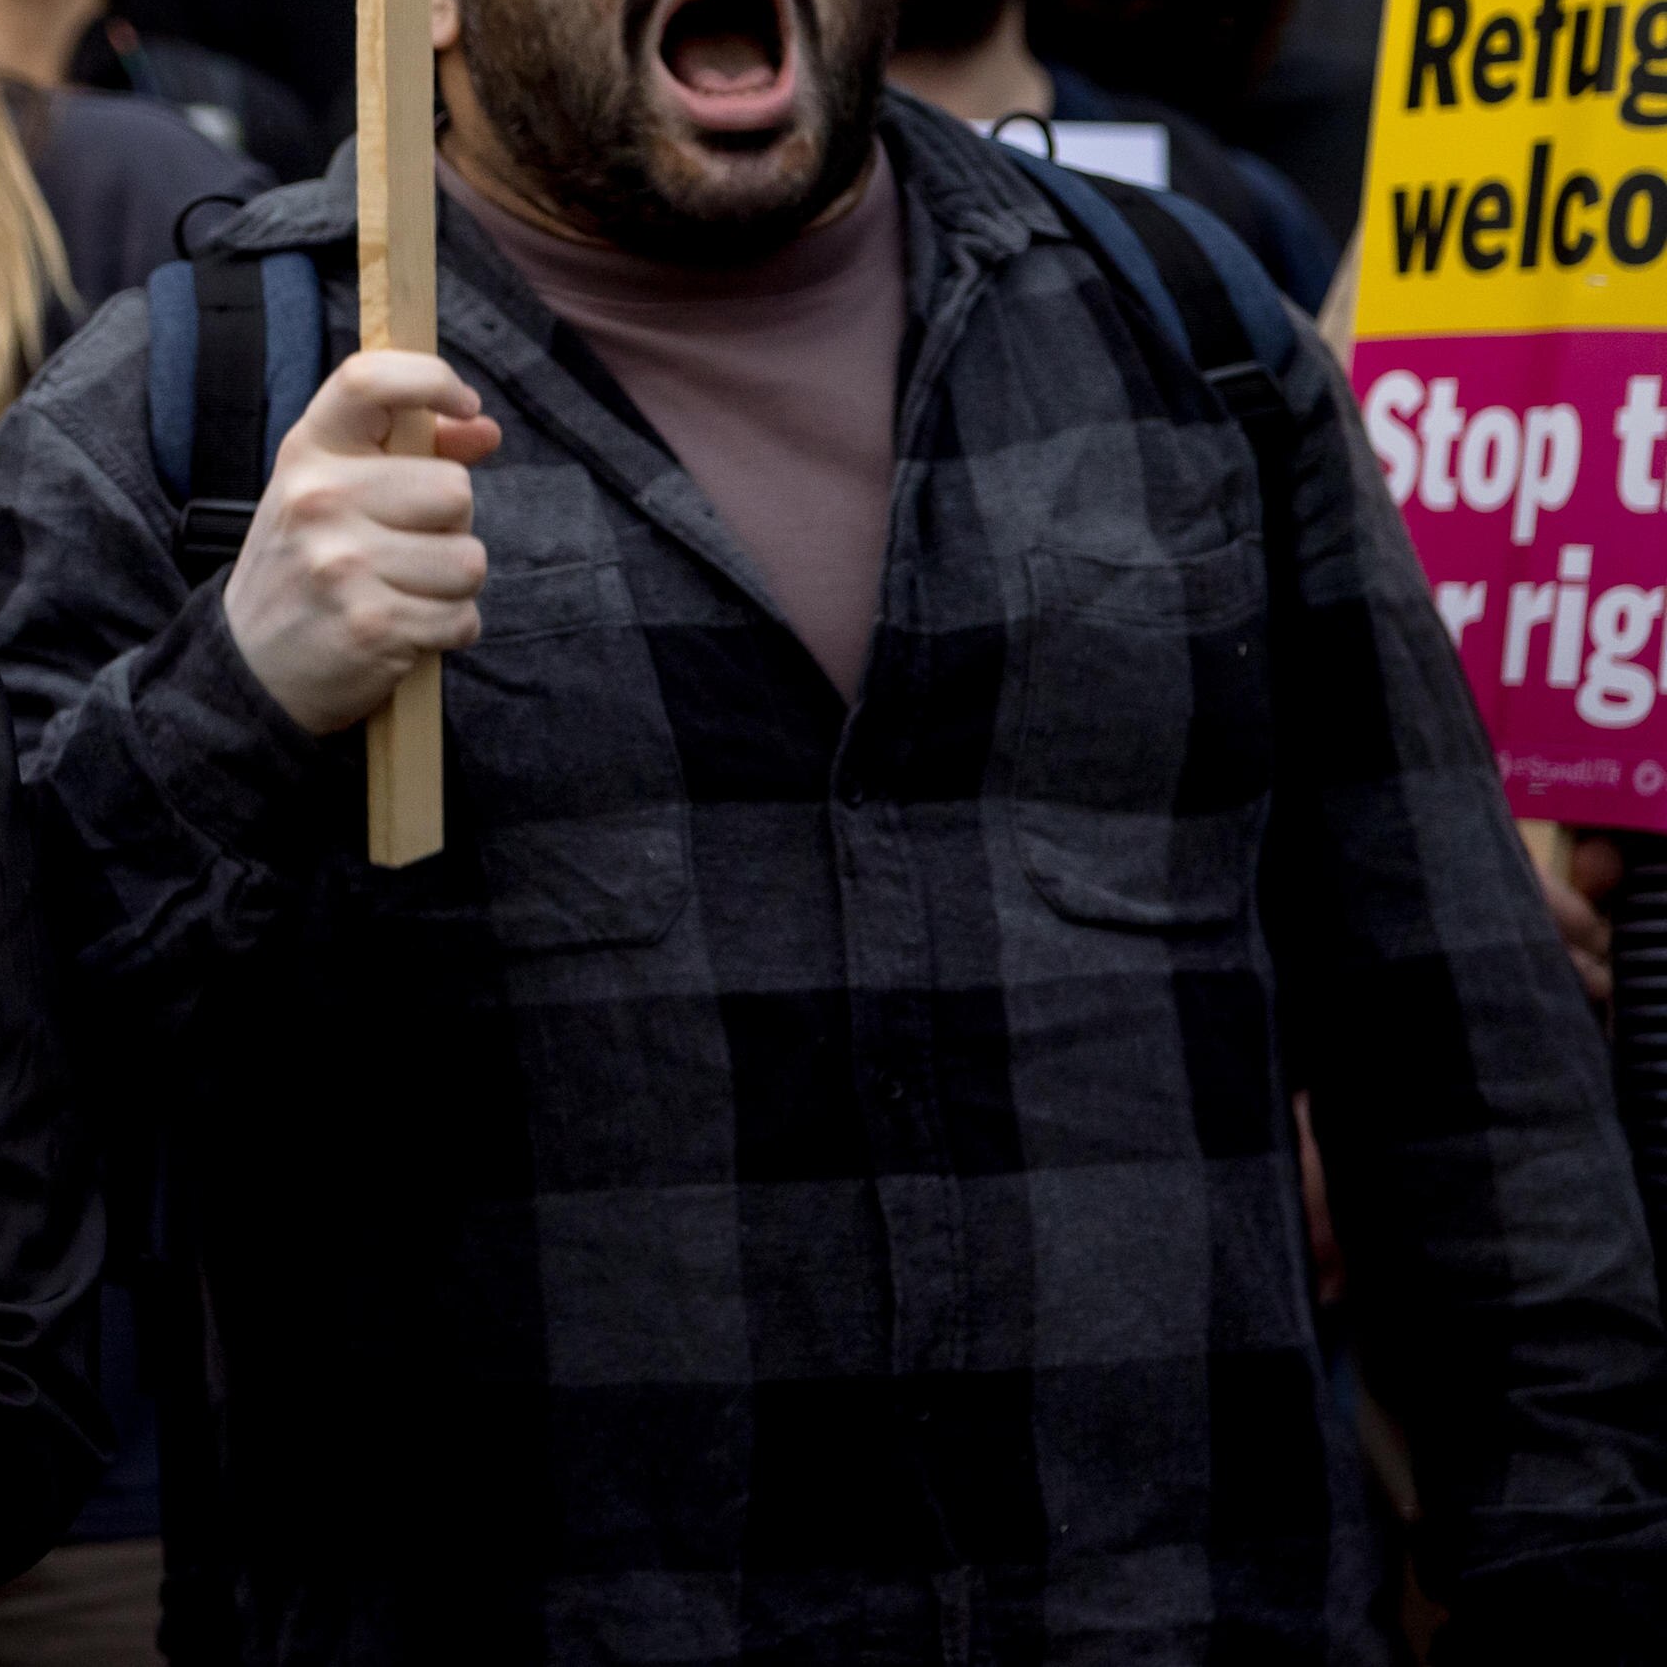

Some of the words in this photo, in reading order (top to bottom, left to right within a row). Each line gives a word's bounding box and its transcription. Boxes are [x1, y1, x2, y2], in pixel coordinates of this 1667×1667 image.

[1391, 137, 1667, 277] welco
[1365, 369, 1583, 547] Stop
[1499, 543, 1667, 731] rig
